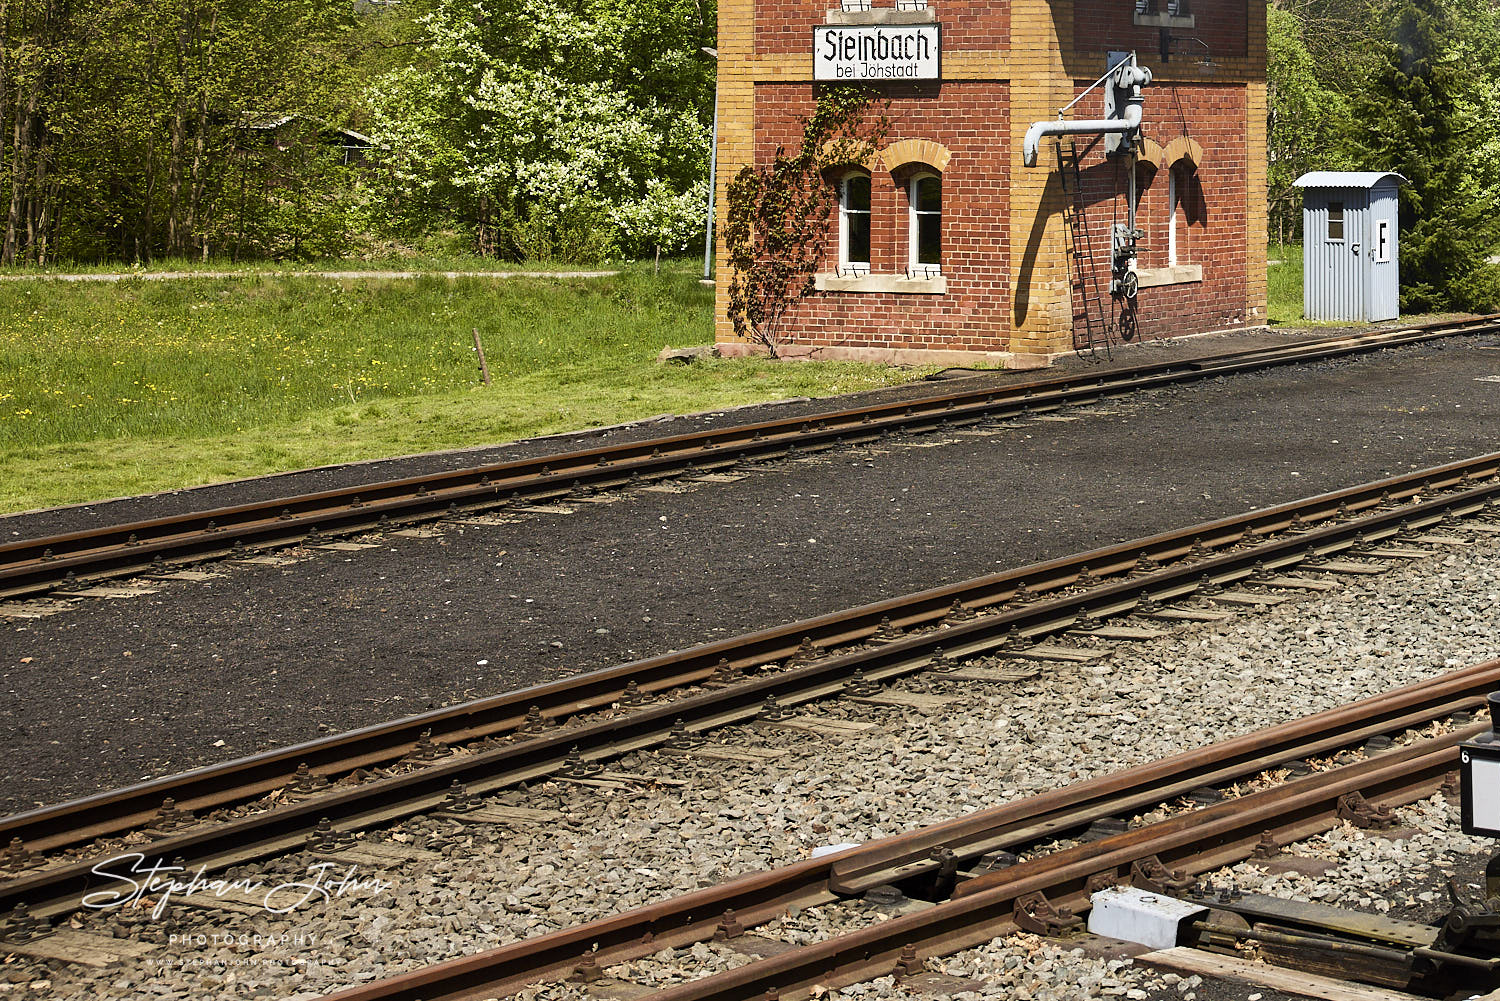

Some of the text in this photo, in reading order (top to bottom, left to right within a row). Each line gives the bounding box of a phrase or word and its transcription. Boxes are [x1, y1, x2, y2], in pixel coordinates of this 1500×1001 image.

[823, 29, 930, 62] Steinbach
[836, 62, 918, 78] bei Jöhstadt
[1379, 222, 1387, 259] F
[1461, 750, 1470, 764] 6
